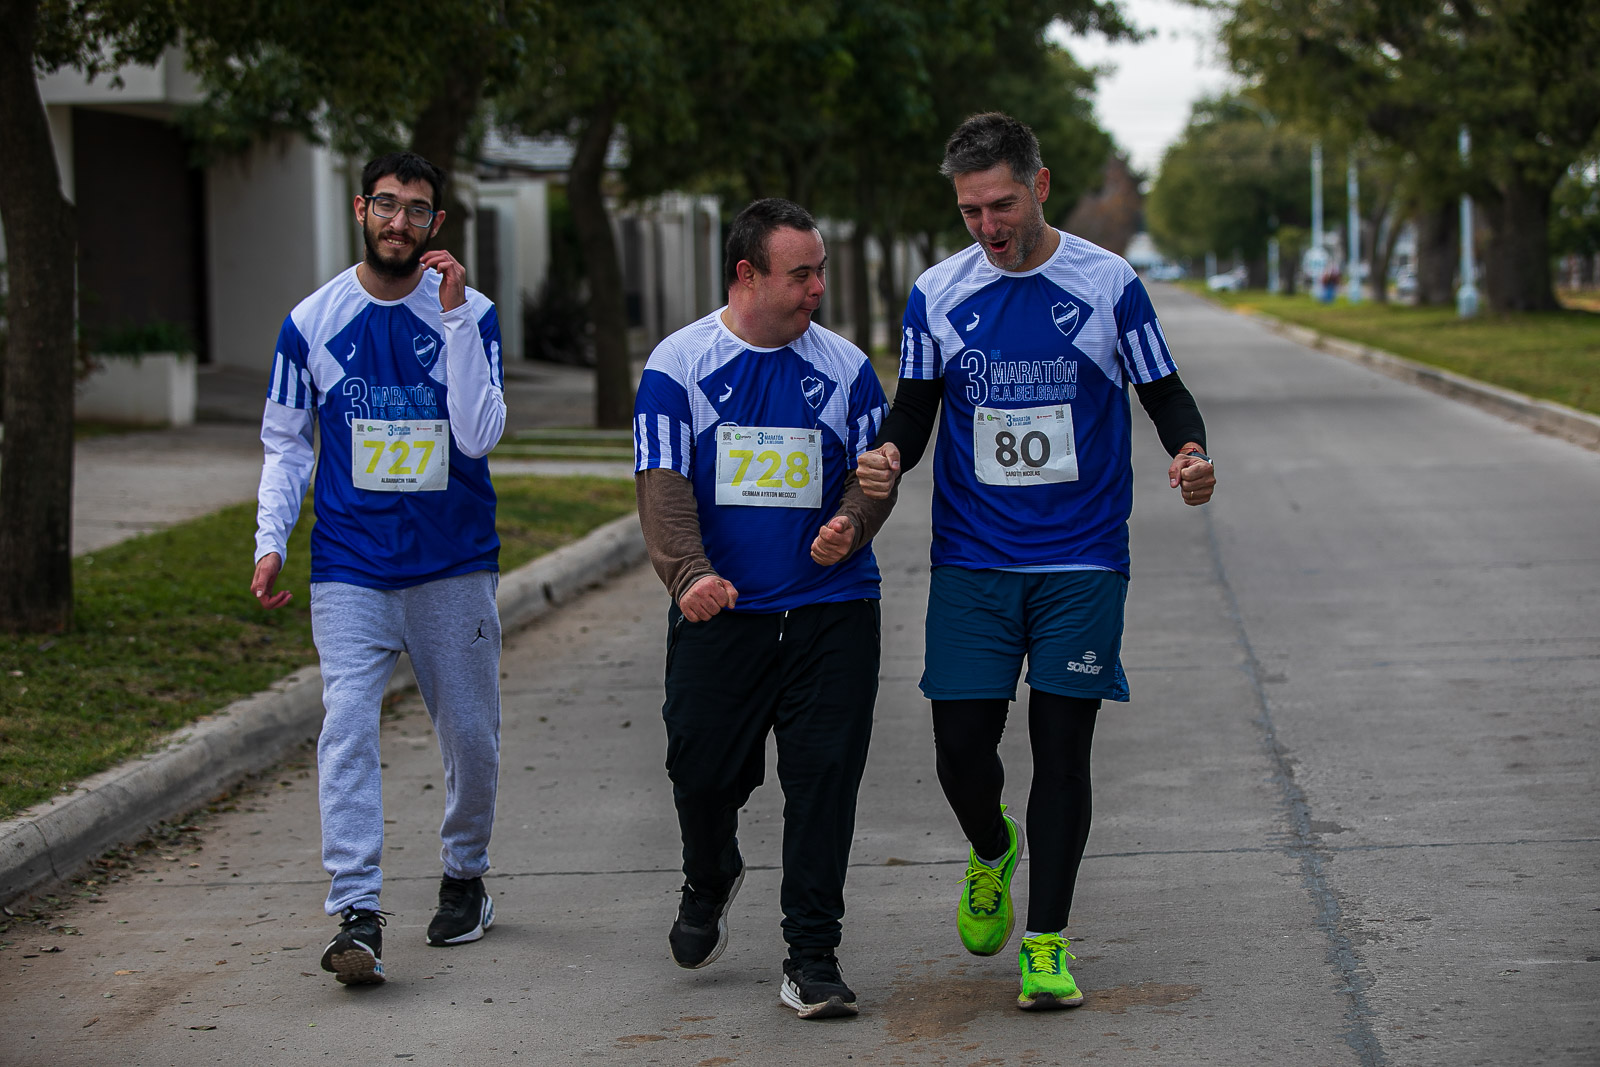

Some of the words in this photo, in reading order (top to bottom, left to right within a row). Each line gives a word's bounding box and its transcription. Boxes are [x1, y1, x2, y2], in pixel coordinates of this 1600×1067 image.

[960, 349, 989, 406] 3
[990, 356, 1078, 384] MARATÓN
[387, 424, 394, 437] 3
[1005, 414, 1013, 427] 3
[757, 432, 765, 445] 3
[995, 430, 1051, 468] 80
[363, 440, 436, 475] 727
[729, 449, 810, 489] 728
